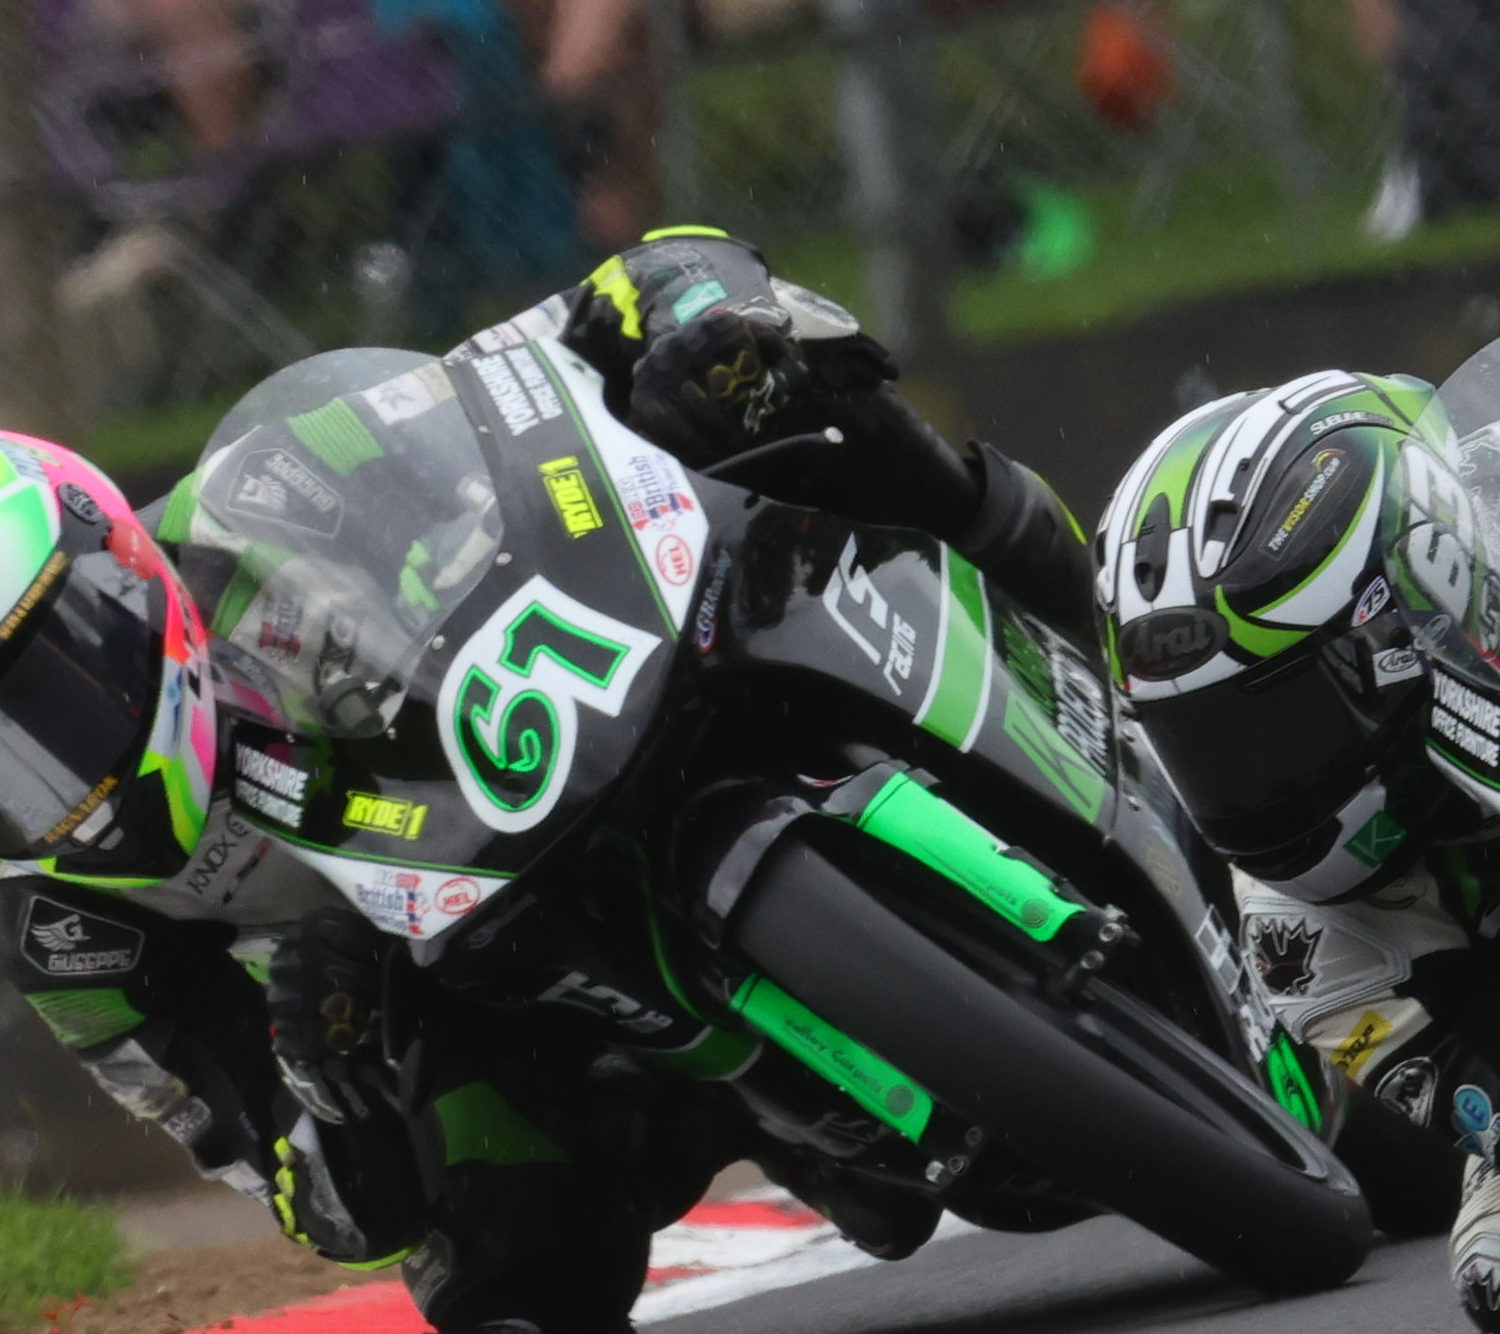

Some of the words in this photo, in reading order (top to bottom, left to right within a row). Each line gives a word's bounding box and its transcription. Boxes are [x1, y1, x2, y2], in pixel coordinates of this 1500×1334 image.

[470, 352, 541, 436] YORKSHIRE
[548, 472, 598, 539] RYDE
[630, 455, 664, 509] British
[884, 611, 916, 696] racing
[1127, 623, 1211, 661] Arai
[454, 599, 632, 813] 61
[235, 742, 309, 795] YORKSHIRE
[347, 794, 405, 831] RYDE
[404, 804, 428, 840] 1
